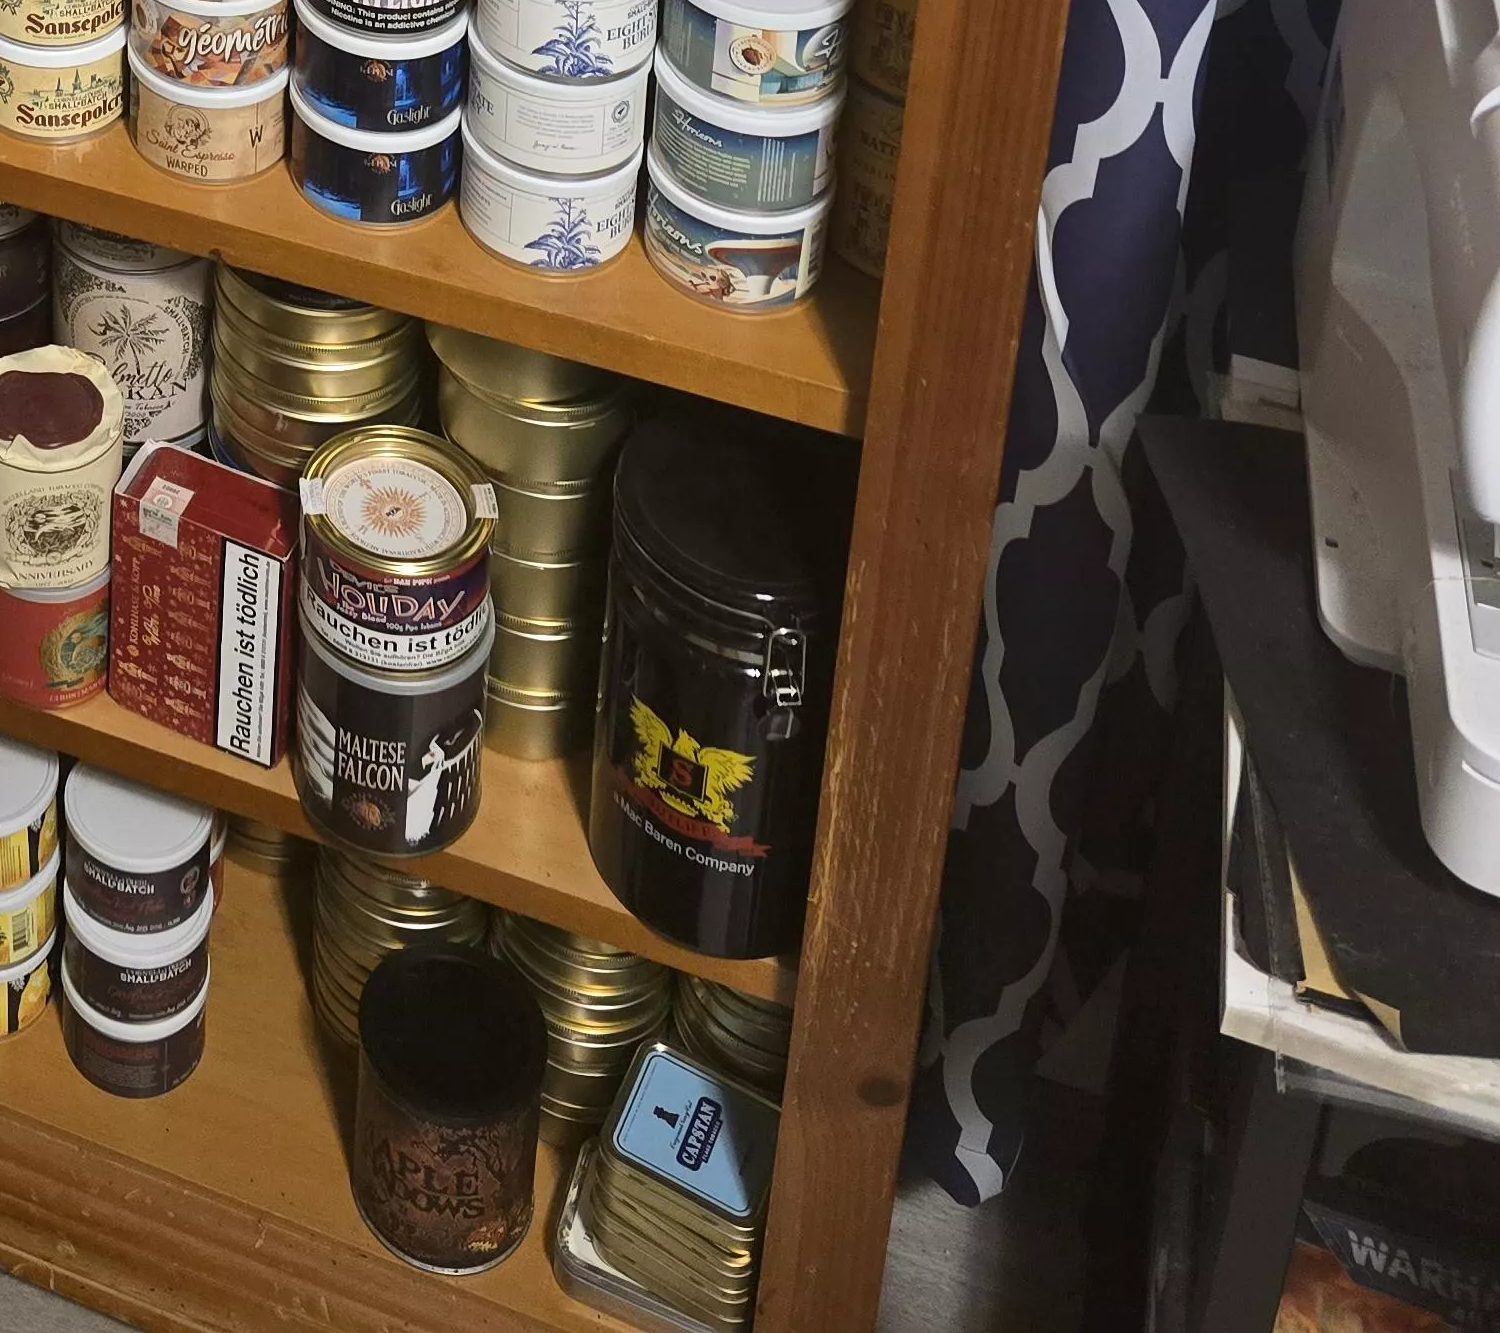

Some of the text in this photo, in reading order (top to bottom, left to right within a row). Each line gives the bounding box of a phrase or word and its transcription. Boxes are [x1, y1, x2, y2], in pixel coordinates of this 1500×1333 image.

[59, 0, 117, 17] SMALL BATCH
[330, 8, 424, 30] Nicotine is an addictive
[357, 3, 445, 22] This product contains
[17, 93, 123, 128] Sansepolcr
[48, 93, 109, 110] SMALL BATCH
[387, 105, 432, 126] Gaslight
[146, 130, 178, 154] Saint
[671, 108, 725, 147] Horizons
[166, 156, 208, 177] WARPED
[391, 193, 432, 215] Gaslight
[318, 557, 466, 621] HOLIDAY
[129, 591, 141, 644] KOHLHASE
[306, 589, 437, 653] Rauchen ist
[230, 552, 260, 753] Rauchen ist tödlich
[339, 727, 407, 765] MALTESE
[338, 756, 404, 792] FALCON
[620, 796, 755, 876] Mac Baren Company
[83, 863, 155, 895] SMALL BATCH
[120, 958, 192, 984] SMALL BATCH
[681, 1101, 716, 1165] CAPSTAN
